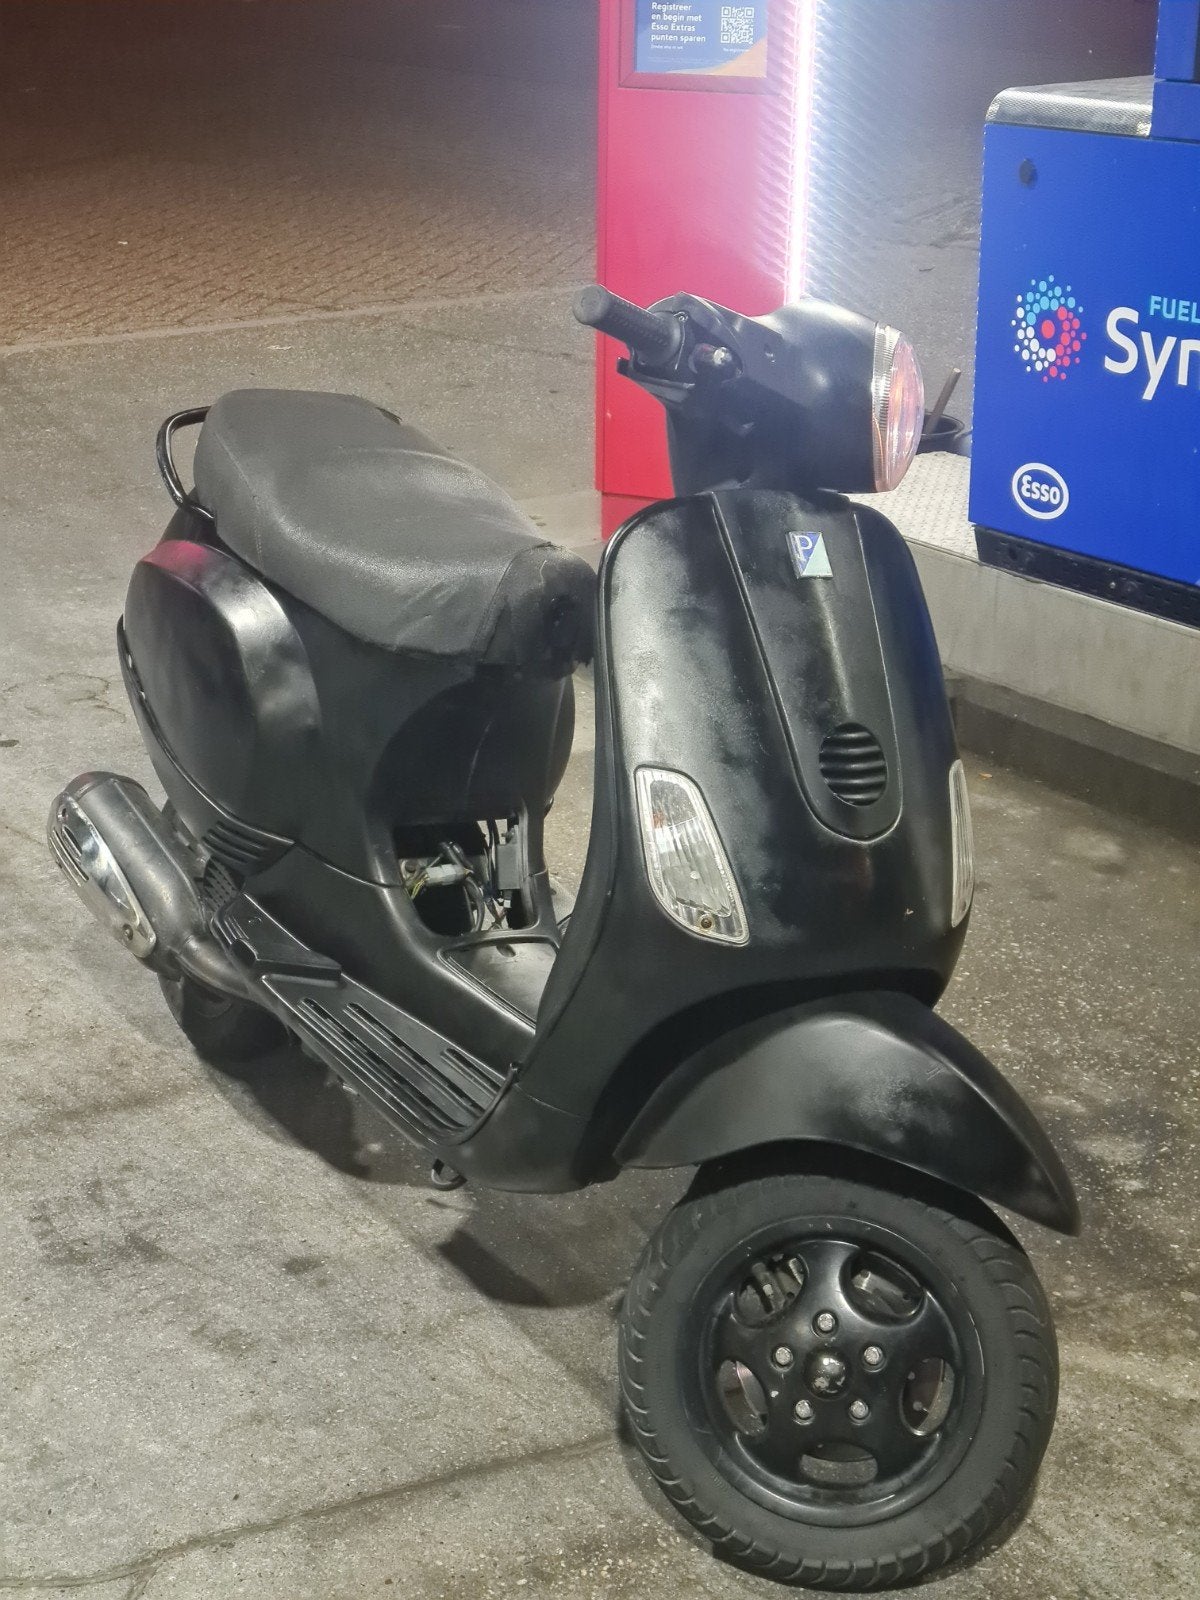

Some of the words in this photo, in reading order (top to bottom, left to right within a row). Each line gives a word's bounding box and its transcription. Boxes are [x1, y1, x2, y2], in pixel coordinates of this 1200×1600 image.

[651, 2, 692, 12] Registreer
[663, 13, 685, 22] begin
[651, 22, 669, 30] Esso
[671, 23, 696, 31] Extras
[651, 34, 678, 42] punten
[680, 35, 706, 43] sparen
[1149, 294, 1200, 324] FUEL
[1021, 475, 1060, 504] Esso
